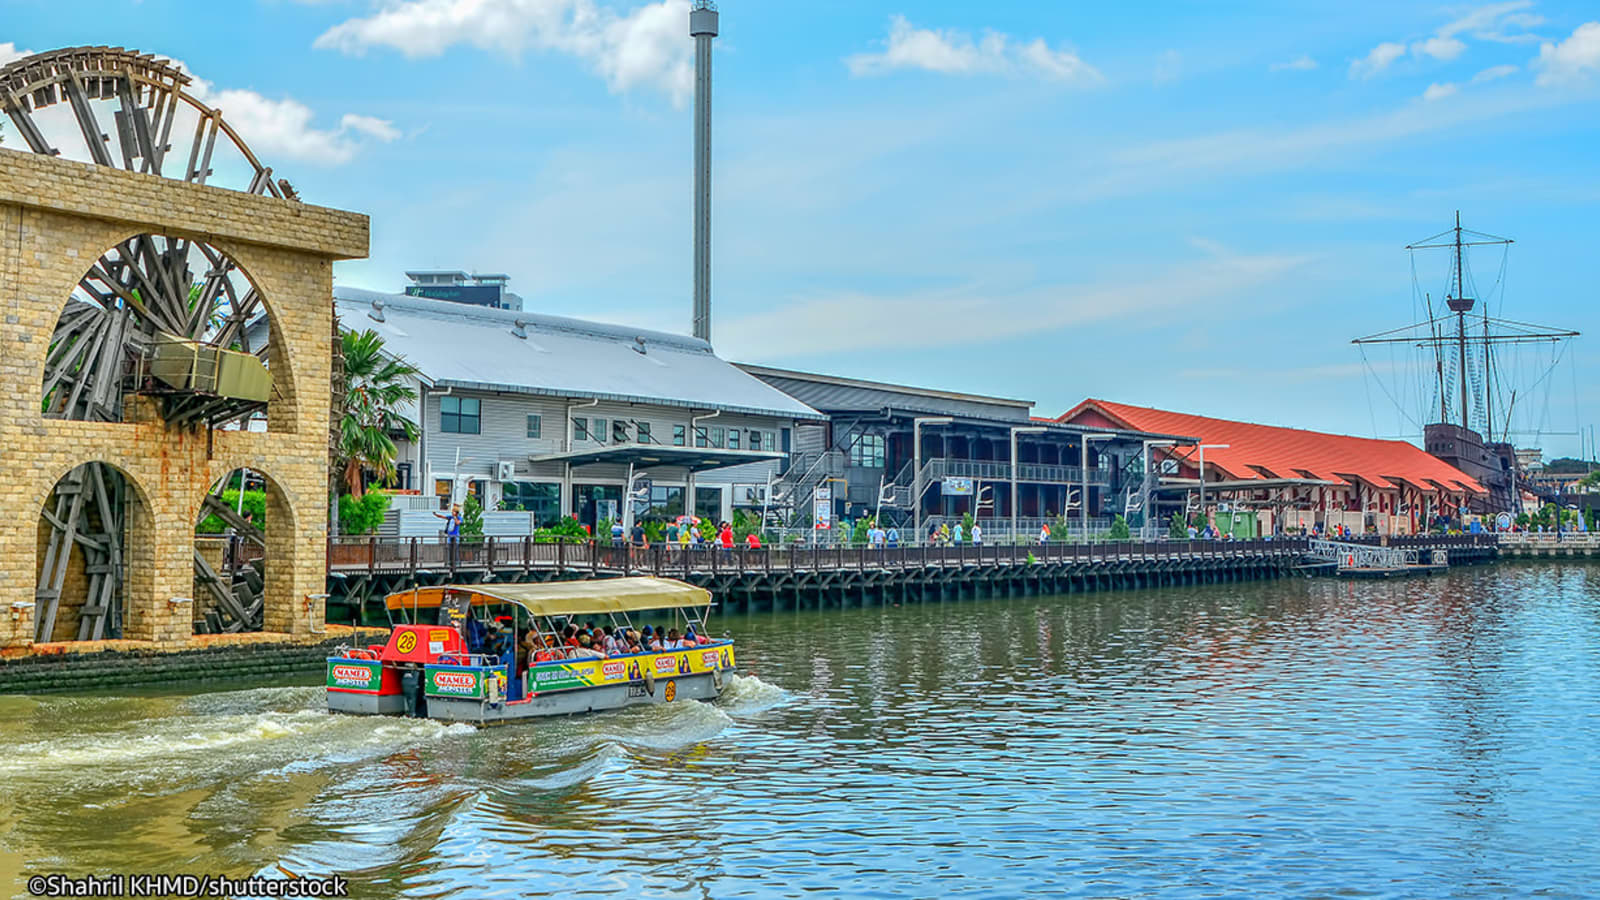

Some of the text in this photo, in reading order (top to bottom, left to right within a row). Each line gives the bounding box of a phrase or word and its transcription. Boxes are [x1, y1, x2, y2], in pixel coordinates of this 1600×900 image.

[399, 634, 415, 650] 28
[336, 669, 368, 678] MAMEE
[437, 675, 471, 685] MAMEE
